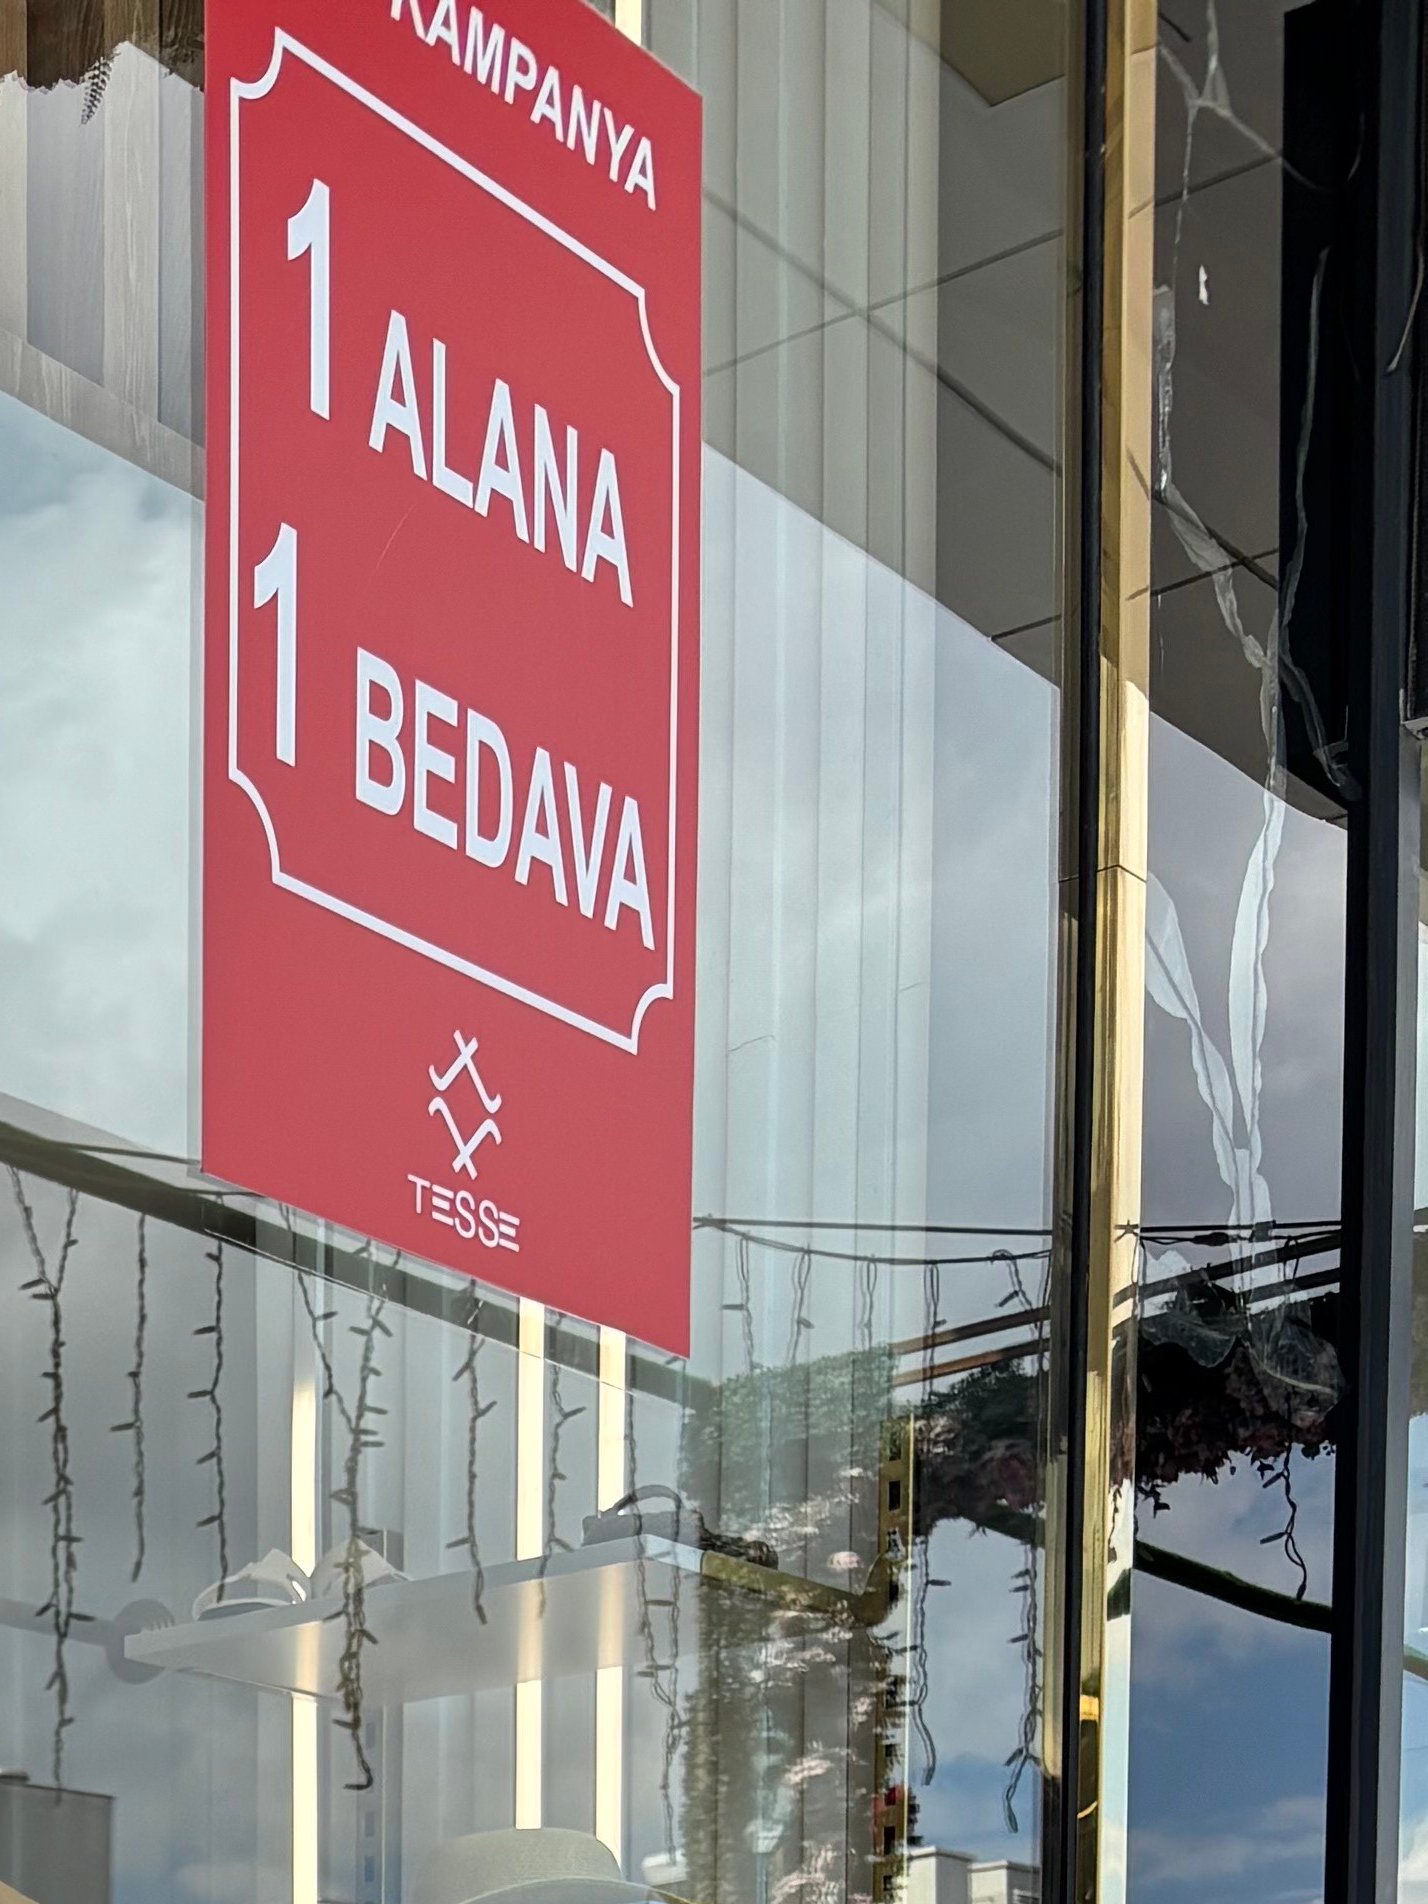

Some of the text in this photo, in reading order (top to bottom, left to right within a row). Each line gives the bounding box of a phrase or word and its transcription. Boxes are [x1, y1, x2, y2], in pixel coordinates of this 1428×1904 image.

[287, 178, 634, 608] 1 ALANA
[253, 522, 656, 951] 1 BEDAVA
[407, 1174, 521, 1254] TESSE
